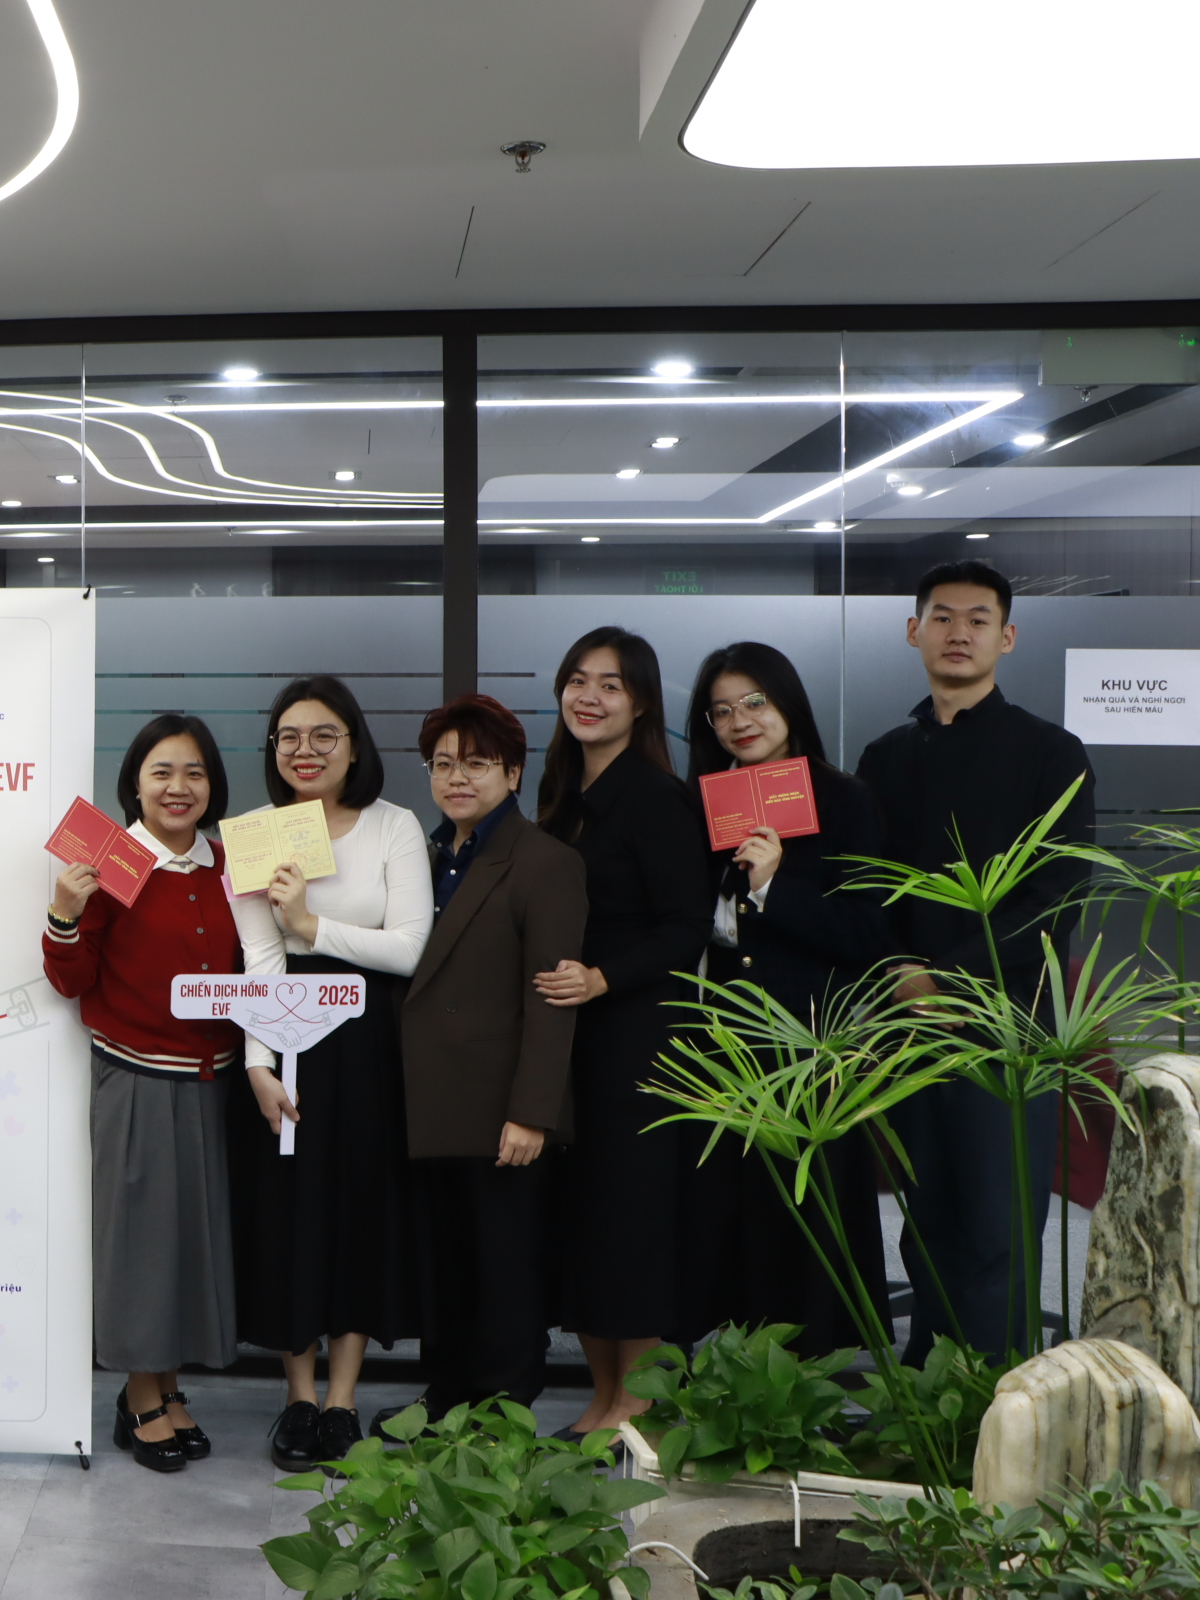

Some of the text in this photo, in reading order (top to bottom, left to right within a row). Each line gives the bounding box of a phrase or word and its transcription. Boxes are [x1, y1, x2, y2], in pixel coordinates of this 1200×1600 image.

[1101, 679, 1168, 693] KHU VỰC
[180, 980, 269, 1000] CHIẾN DỊCH HỒNG
[318, 985, 360, 1006] 2025
[211, 1002, 231, 1016] EVF
